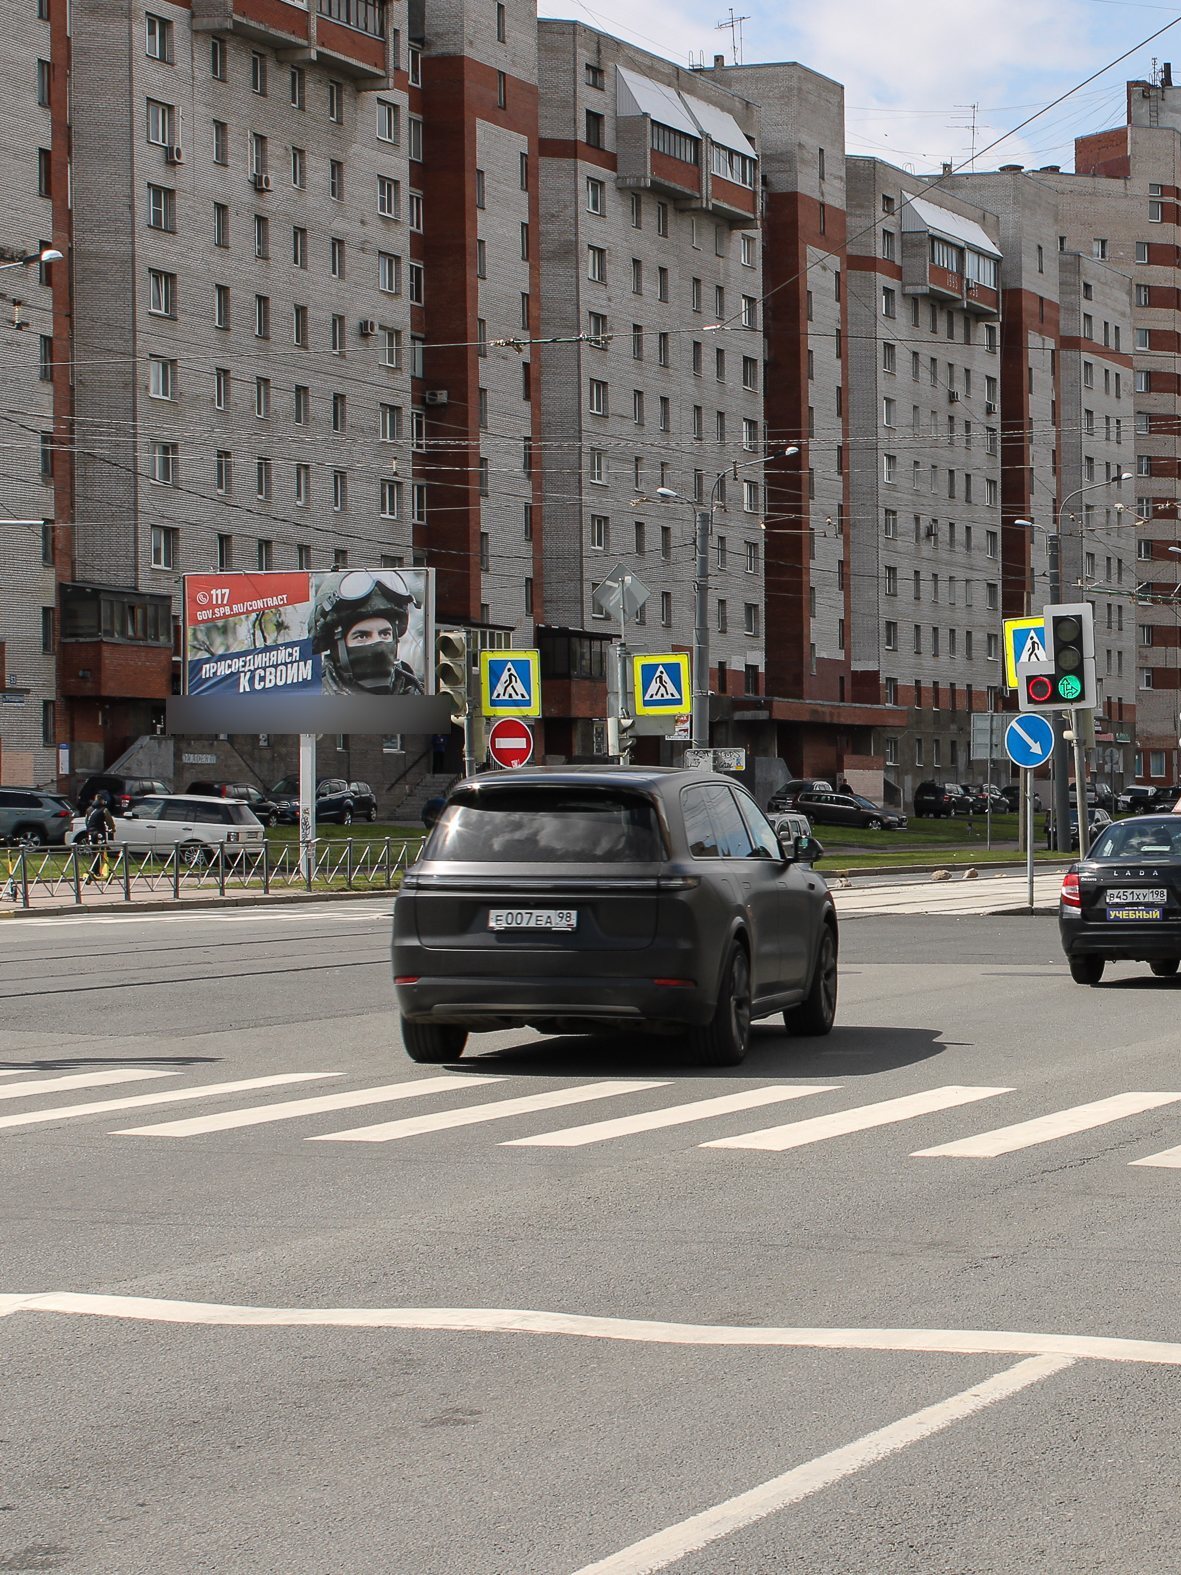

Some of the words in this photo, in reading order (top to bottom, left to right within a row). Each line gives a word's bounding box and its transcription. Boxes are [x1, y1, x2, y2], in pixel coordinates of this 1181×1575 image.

[196, 594, 288, 621] GOV.SPB.RU/CONTRACT
[210, 588, 230, 605] 117
[201, 646, 300, 679] ПРИСОЕДИНЯЙСЯ
[239, 671, 251, 693] К
[254, 659, 312, 691] СВОИМ
[1109, 909, 1160, 920] УЧЕБНЫЙ
